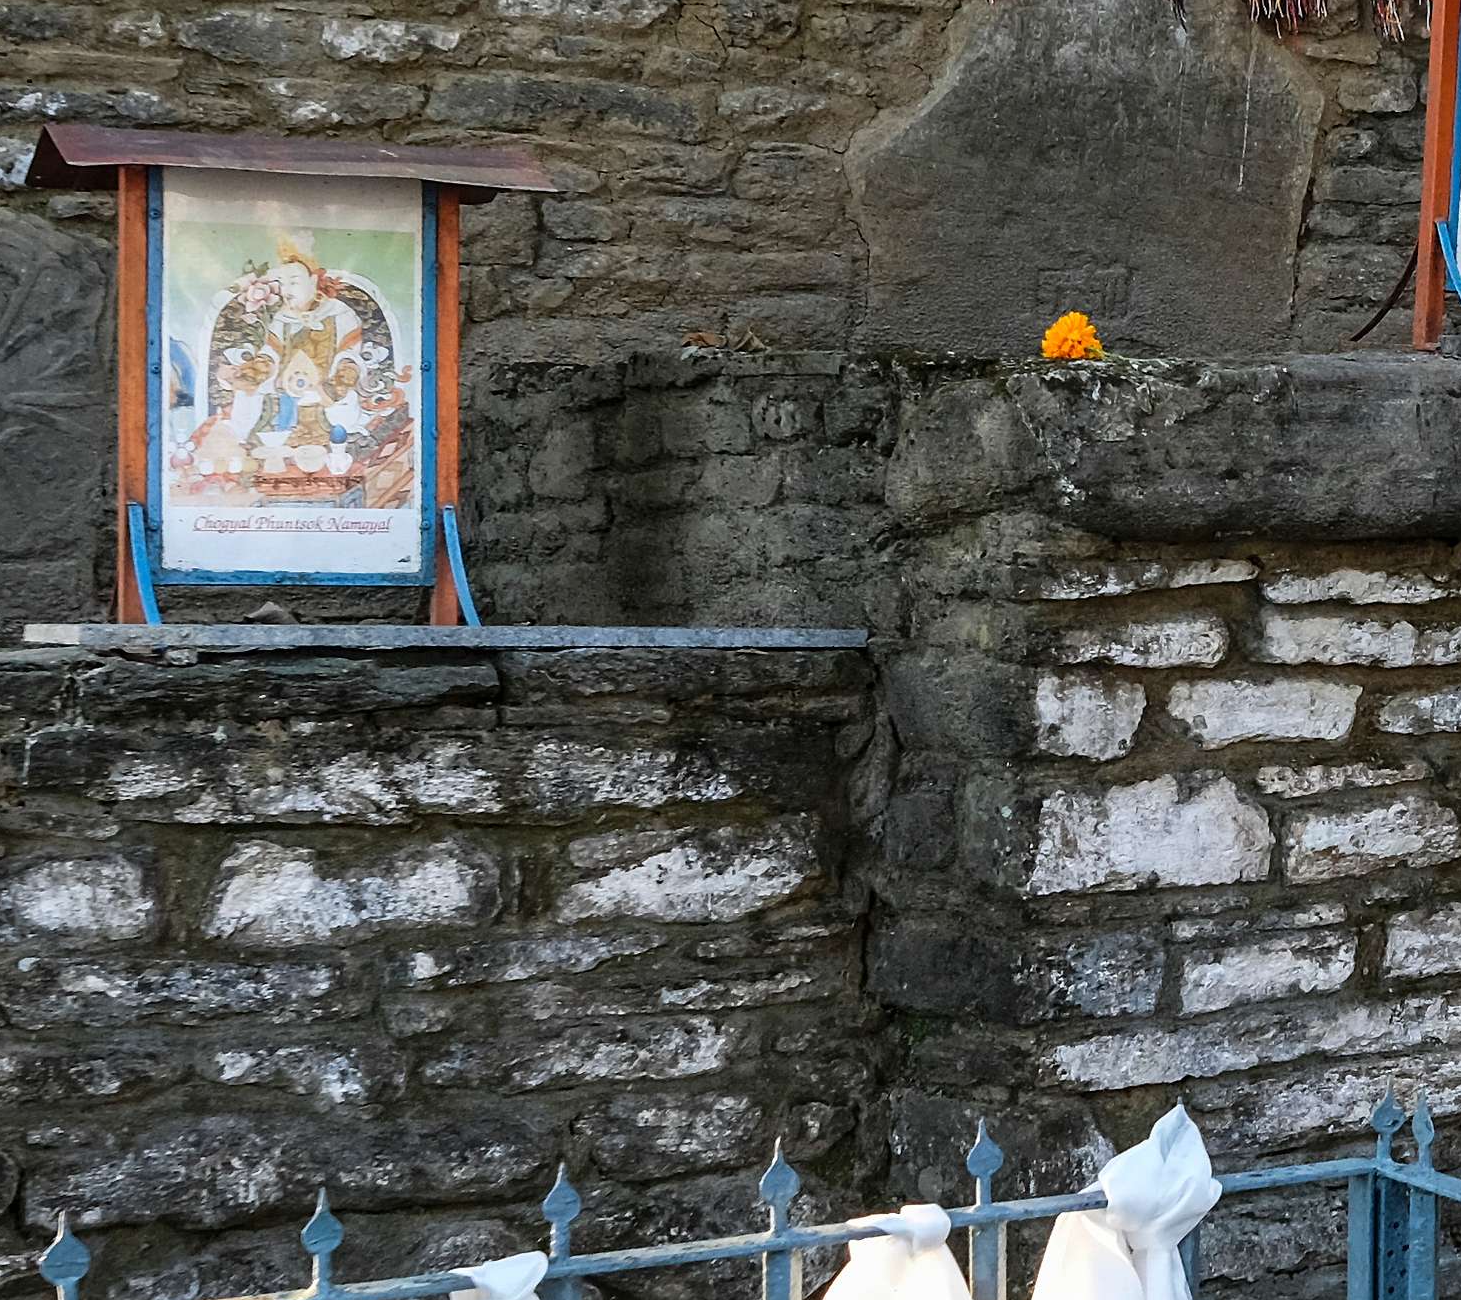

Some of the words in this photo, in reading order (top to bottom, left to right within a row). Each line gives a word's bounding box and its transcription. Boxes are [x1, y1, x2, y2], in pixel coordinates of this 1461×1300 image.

[193, 515, 252, 533] Chogyal
[255, 515, 323, 532] Phuntsok
[327, 516, 392, 534] Namgyal
